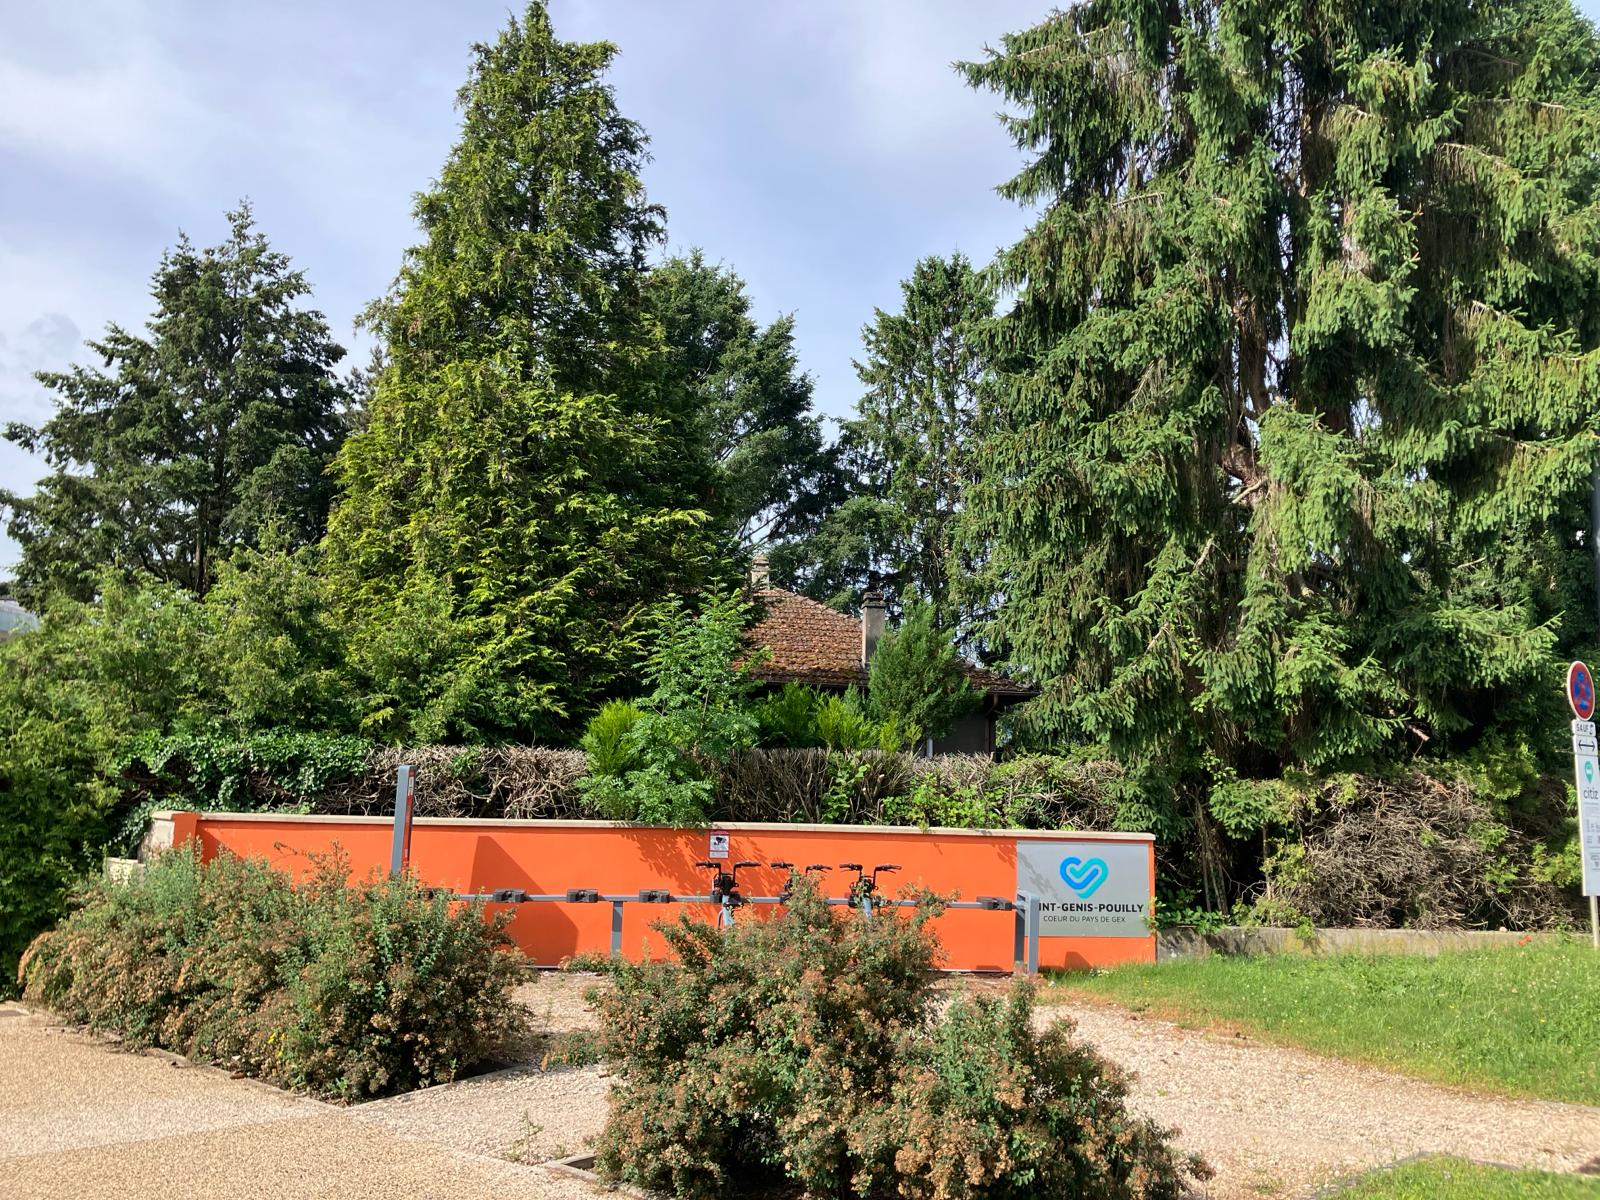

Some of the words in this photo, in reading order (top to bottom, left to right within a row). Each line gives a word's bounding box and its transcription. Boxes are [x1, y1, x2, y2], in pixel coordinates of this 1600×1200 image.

[1038, 902, 1145, 913] INT-GENIS-POUILLY
[1069, 915, 1080, 923] DU
[1081, 915, 1099, 923] PAYS
